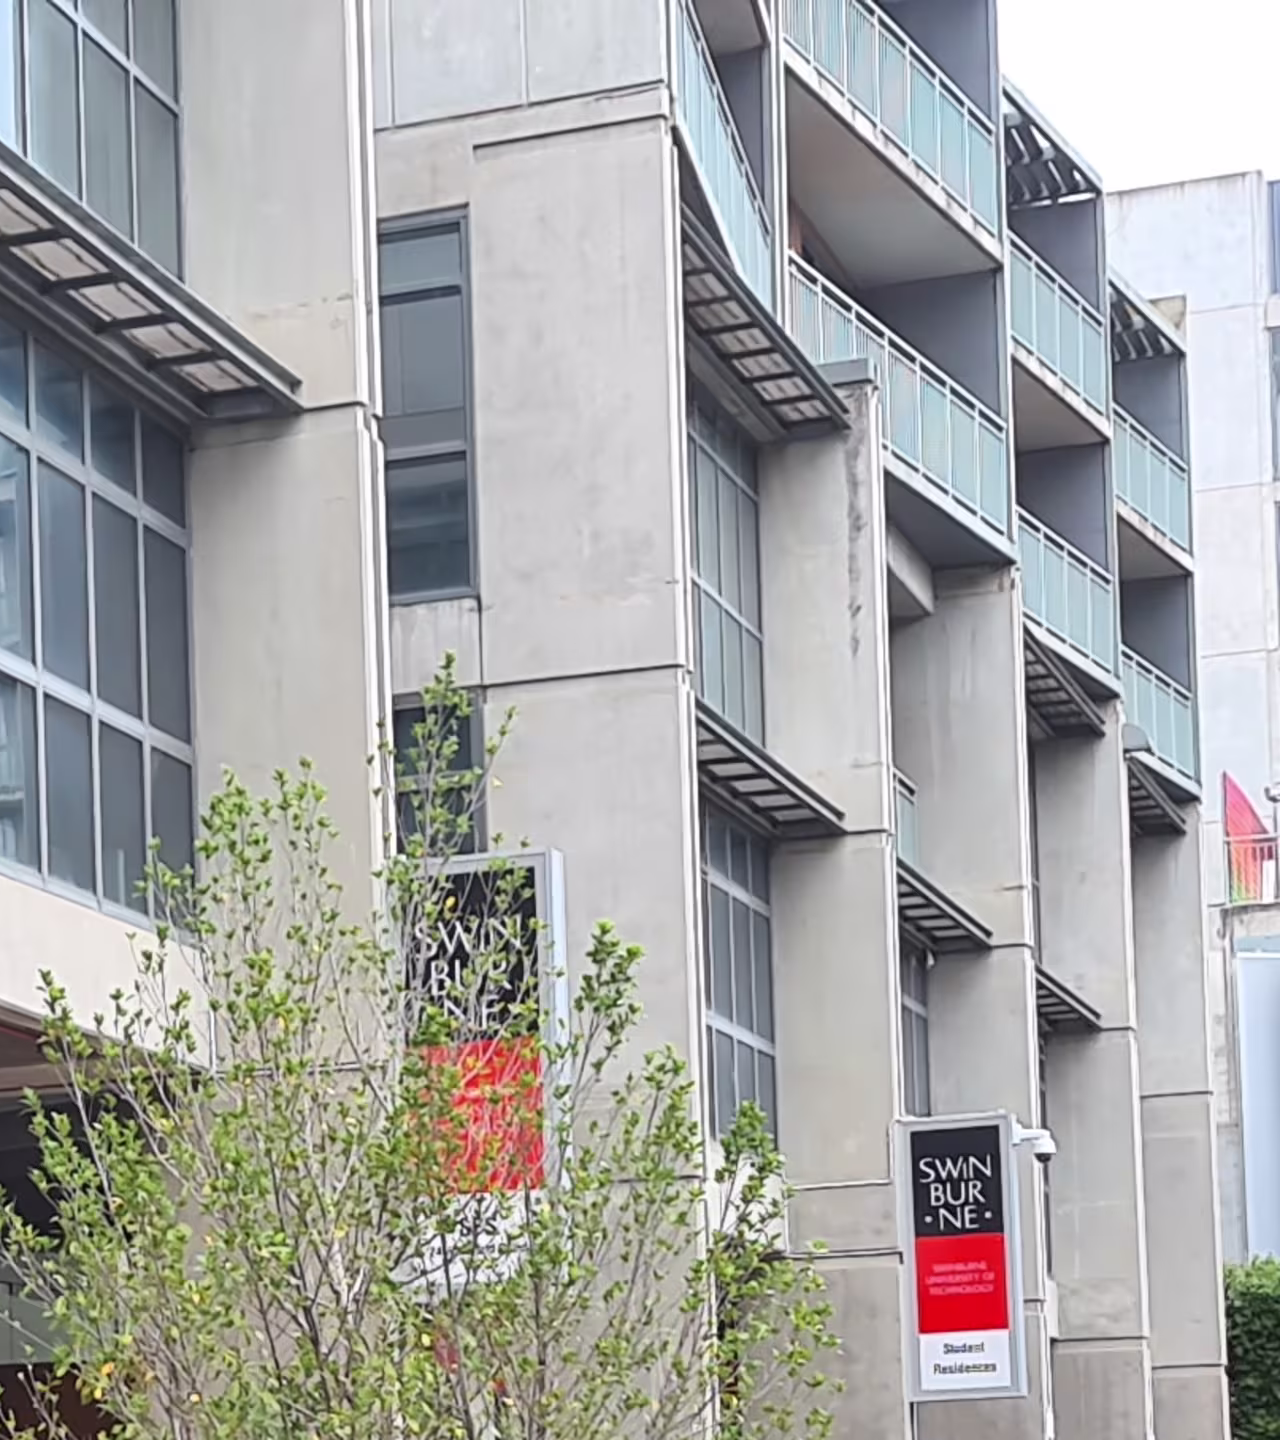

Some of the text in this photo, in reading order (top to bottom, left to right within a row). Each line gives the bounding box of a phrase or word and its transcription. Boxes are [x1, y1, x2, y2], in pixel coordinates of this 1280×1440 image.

[919, 1154, 993, 1184] SWIN
[930, 1180, 986, 1207] BUR
[939, 1205, 979, 1231] NE
[943, 1341, 985, 1355] Student
